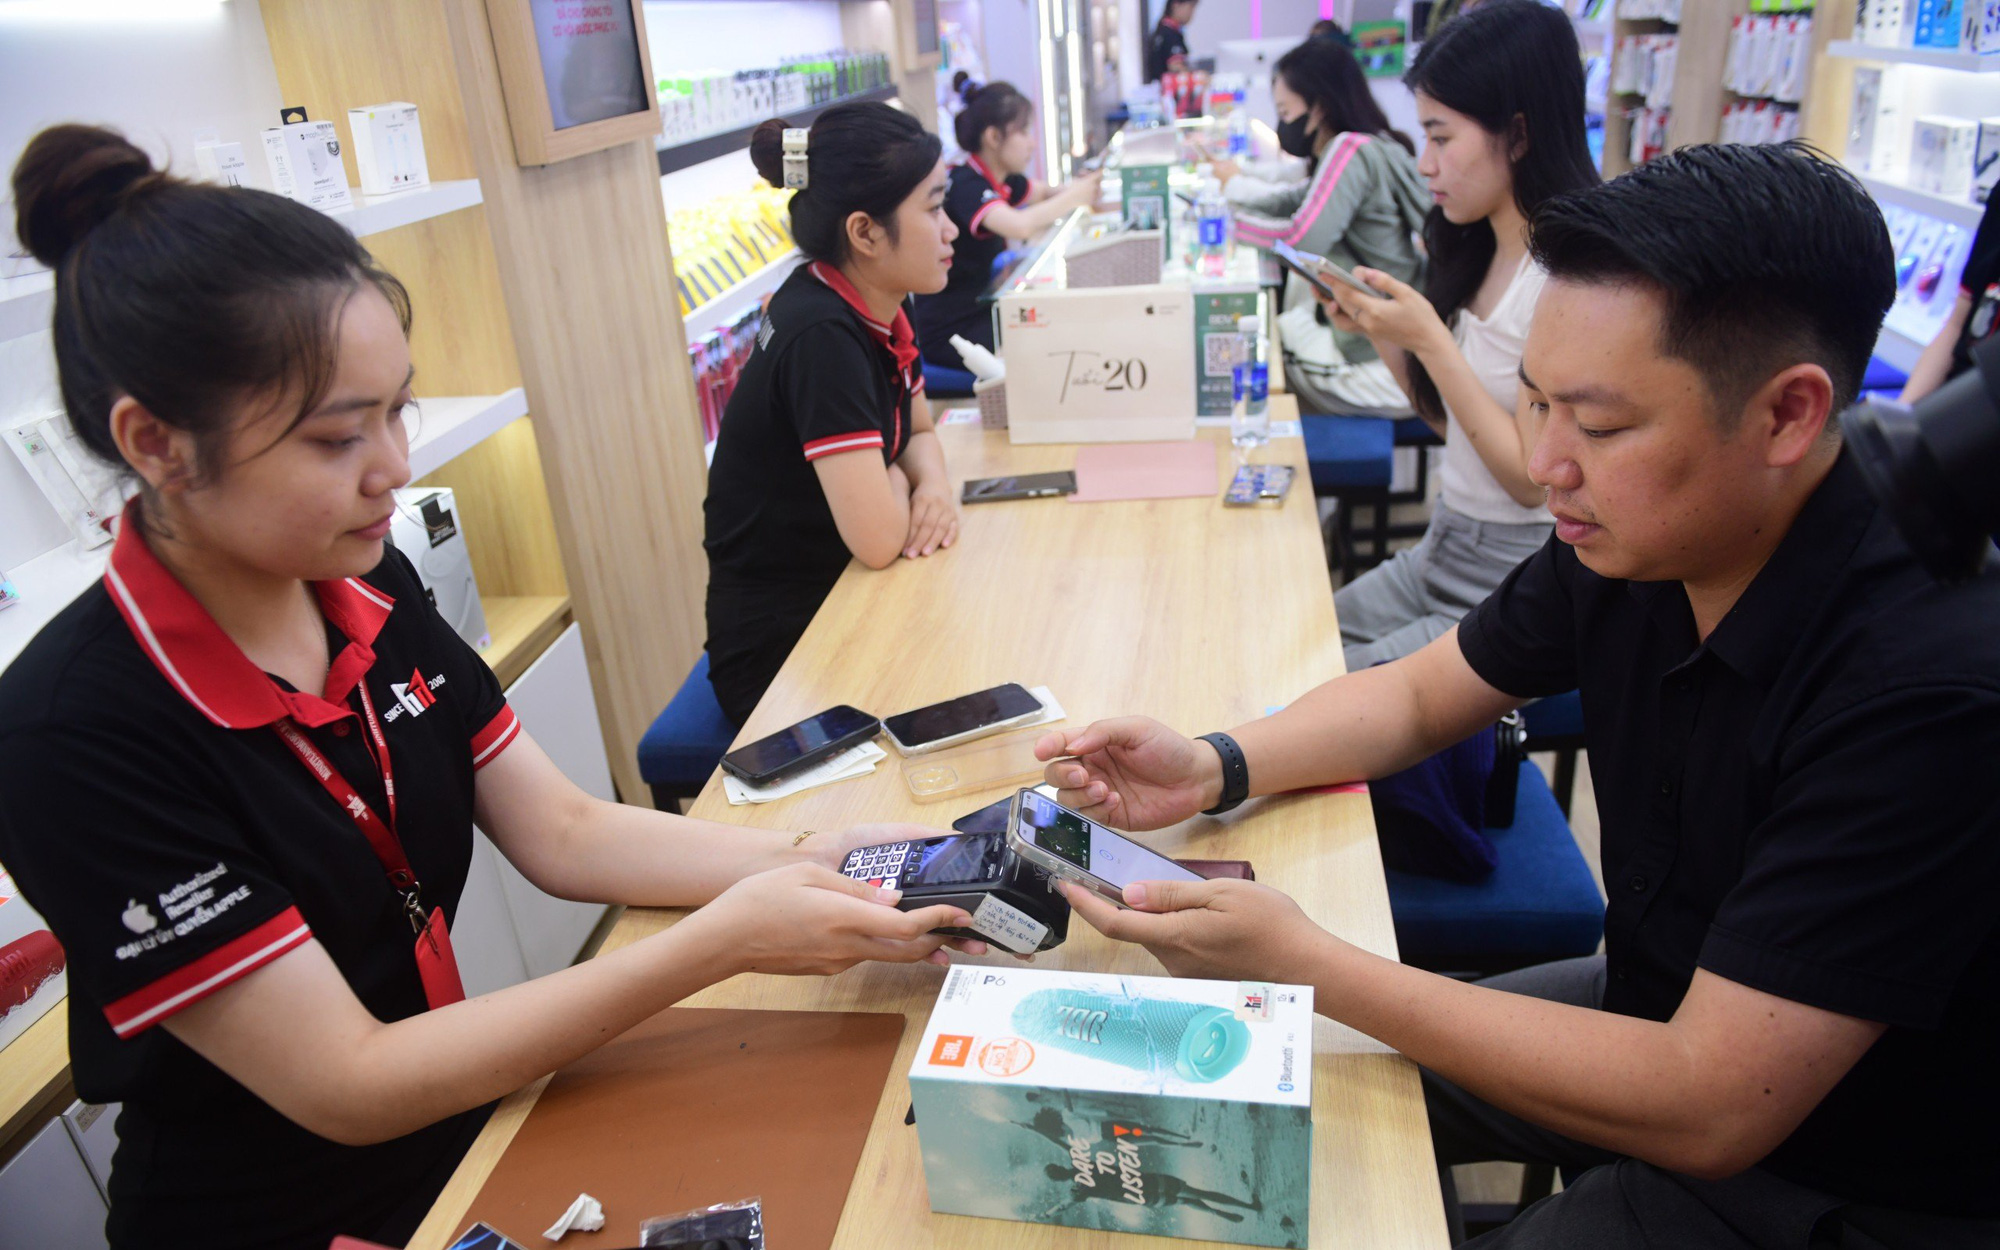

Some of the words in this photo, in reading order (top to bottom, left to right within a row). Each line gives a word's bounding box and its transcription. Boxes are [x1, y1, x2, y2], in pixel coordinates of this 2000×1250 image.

[1103, 357, 1147, 391] 20
[384, 702, 405, 723] SINCE
[427, 674, 446, 691] 2003
[158, 862, 228, 908] Authorized
[213, 884, 252, 914] APPLE
[165, 887, 216, 920] Reseller
[1057, 1005, 1109, 1045] JBL
[1280, 1047, 1293, 1082] Bluetooth
[1067, 1134, 1096, 1188] DARE
[1095, 1151, 1116, 1175] TO
